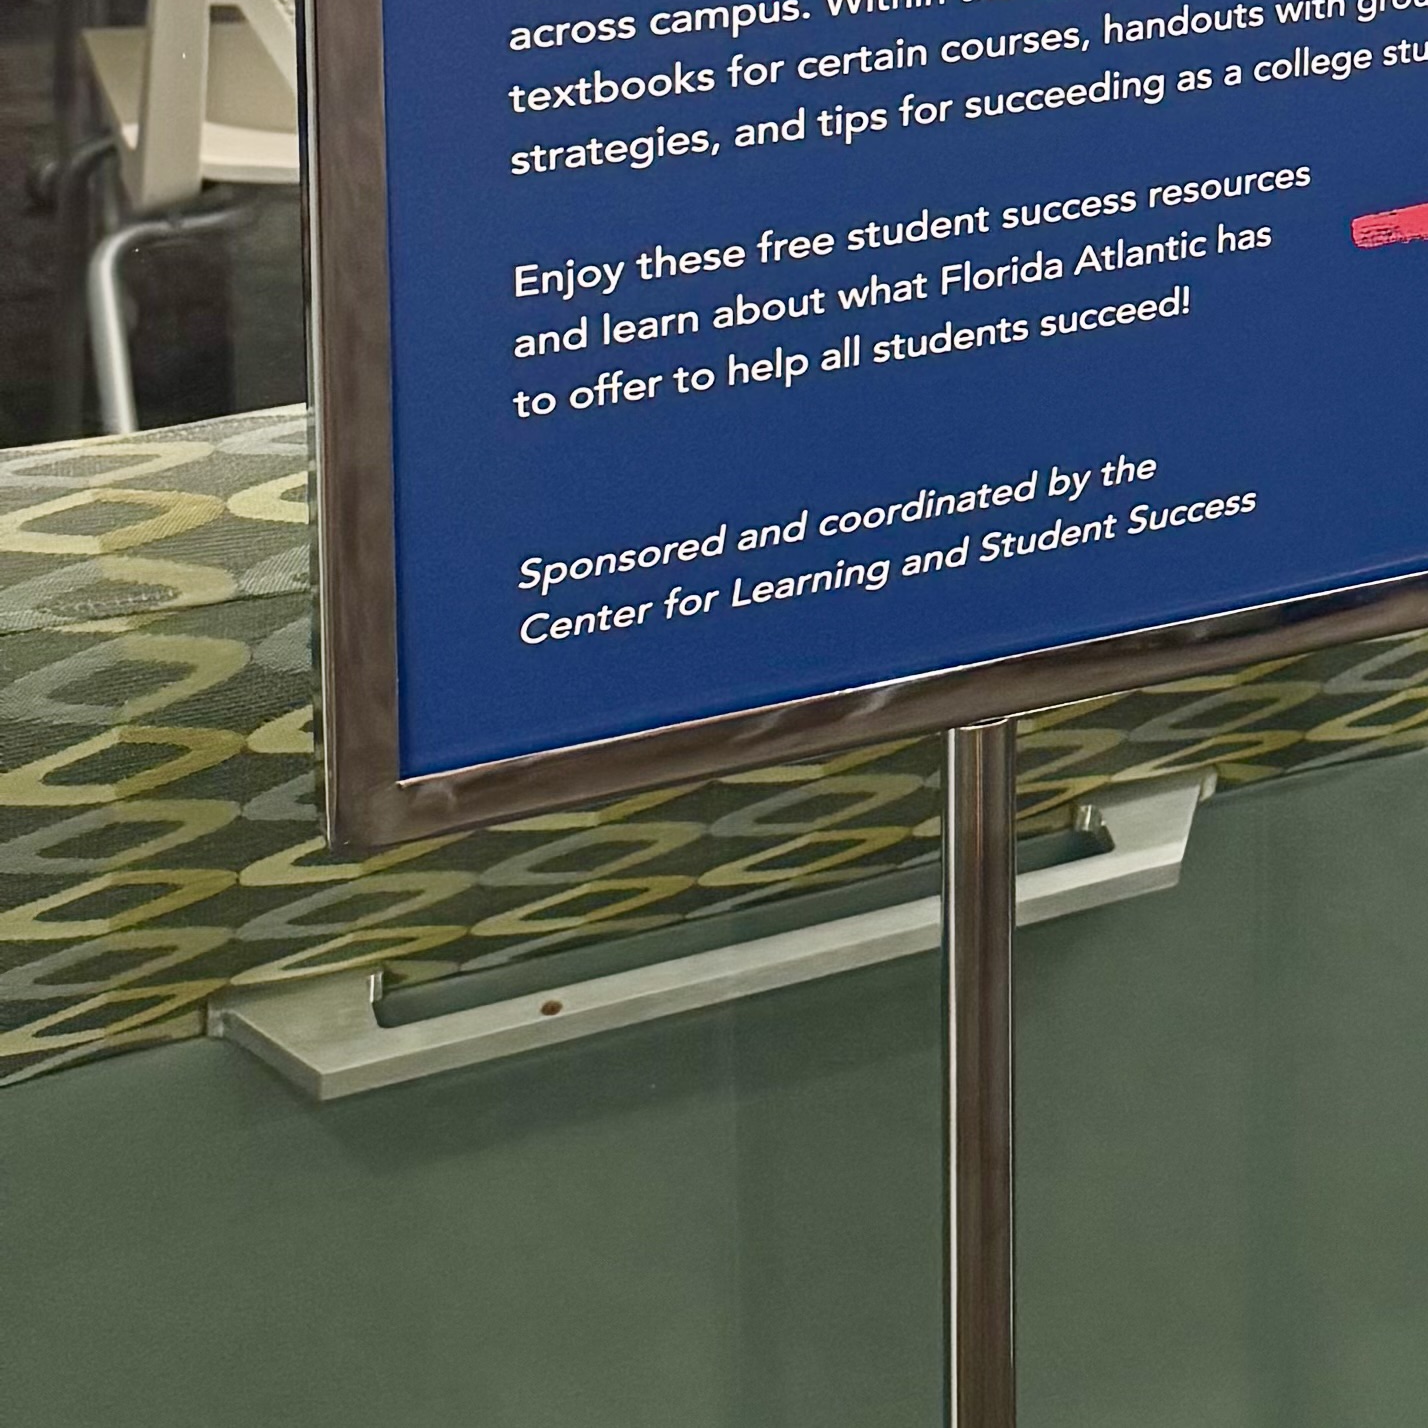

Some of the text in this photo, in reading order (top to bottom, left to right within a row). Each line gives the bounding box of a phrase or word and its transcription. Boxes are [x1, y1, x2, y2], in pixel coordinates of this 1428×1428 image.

[507, 61, 715, 113] textbooks
[726, 53, 785, 88] for
[797, 38, 927, 80] certain
[941, 27, 1090, 63] courses,
[1104, 3, 1264, 44] handouts
[509, 16, 636, 51] across
[649, 0, 811, 39] campus.
[511, 125, 720, 175] strategies,
[734, 106, 805, 147] and
[816, 104, 888, 145] tips
[898, 93, 954, 127] for
[965, 70, 1165, 119] succeeding
[1176, 68, 1213, 92] as
[1223, 64, 1242, 86] a
[1253, 46, 1373, 82] college
[514, 223, 1272, 358] and learn about what Florida Atlantic has
[515, 166, 1311, 301] Enjoy these free student success resources
[512, 285, 1190, 418] to offer to help all students succeed!
[518, 454, 1157, 596] Sponsored and coordinated by the
[520, 492, 1257, 644] Center for Learning and Student Success
